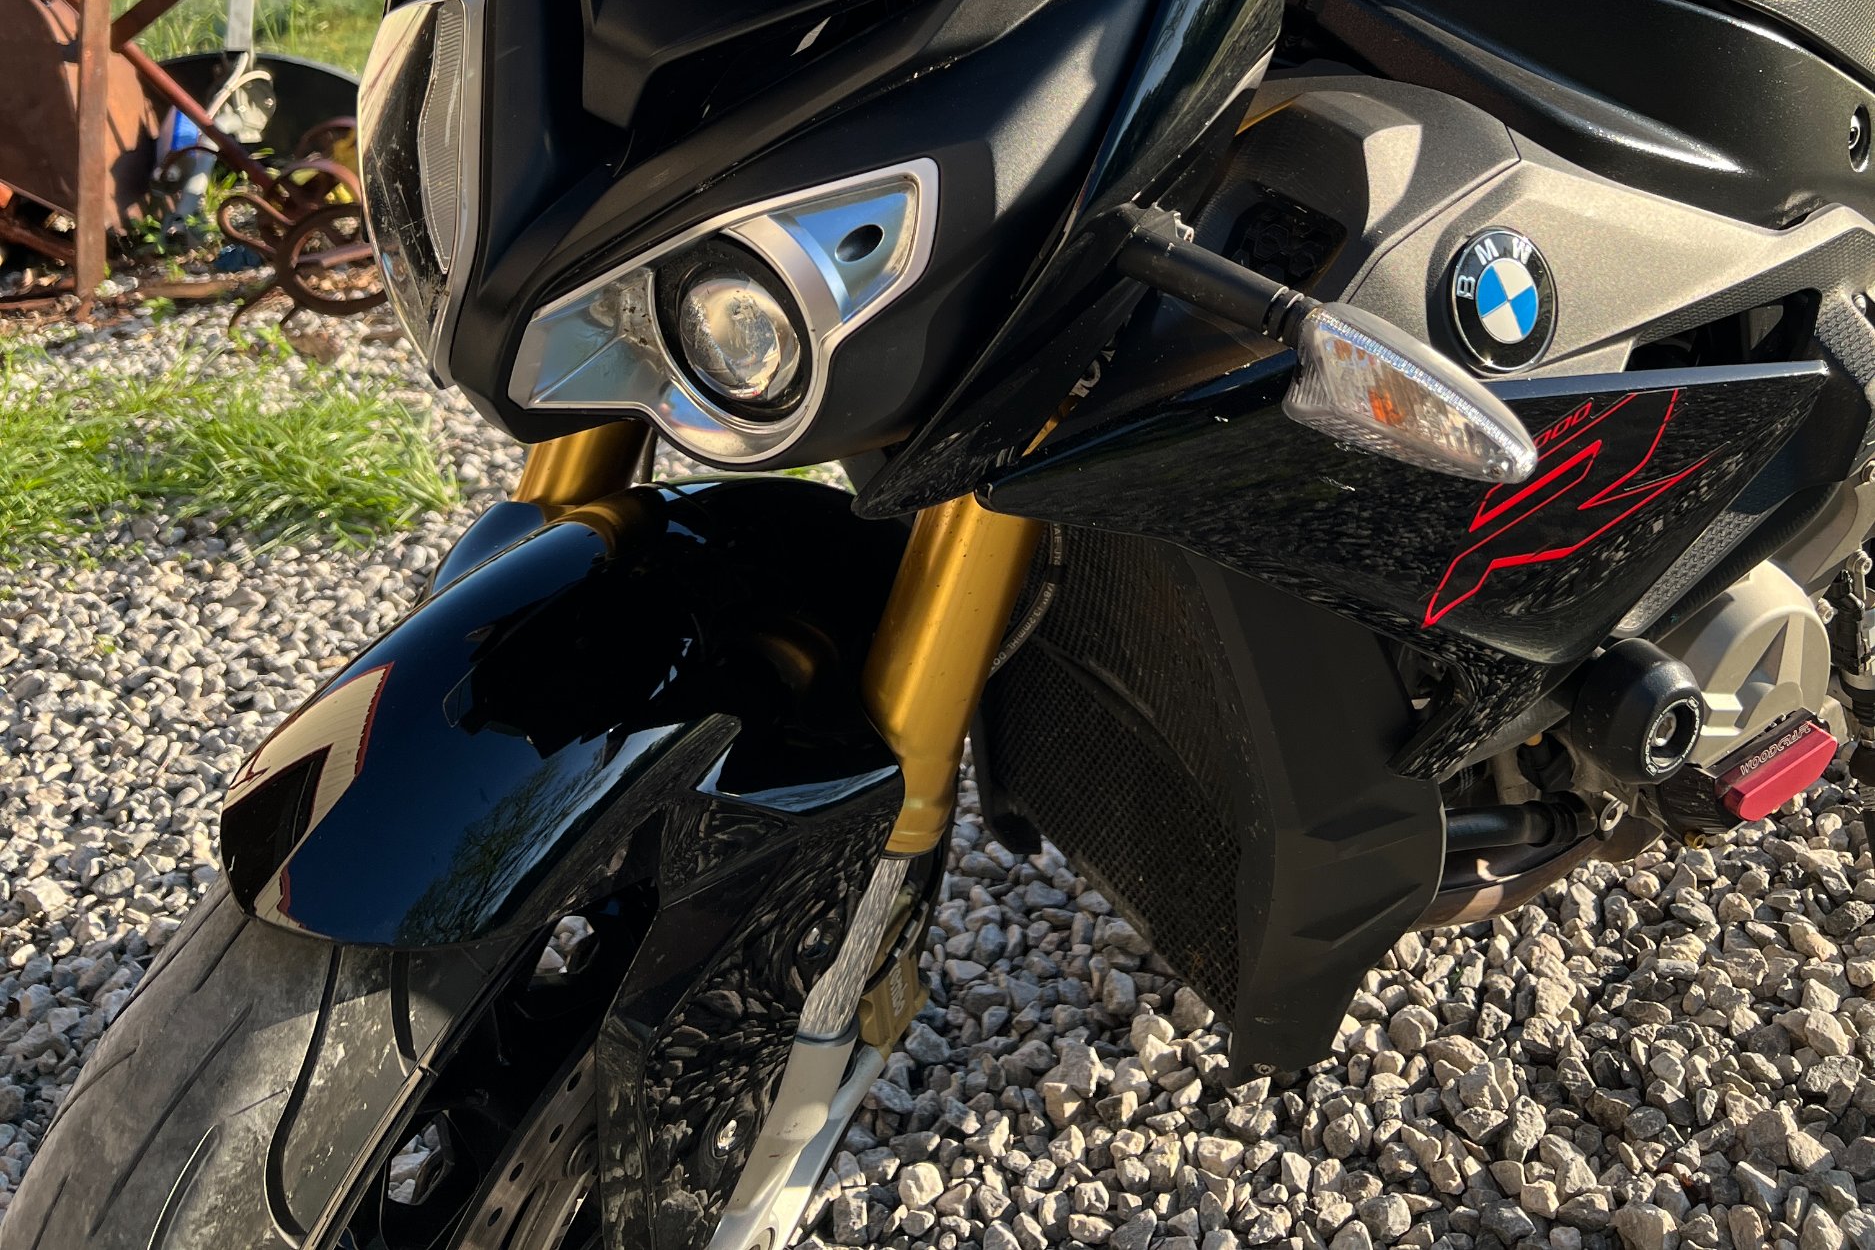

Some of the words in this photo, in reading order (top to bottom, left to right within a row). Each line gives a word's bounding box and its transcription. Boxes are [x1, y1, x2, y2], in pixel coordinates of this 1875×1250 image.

[1456, 237, 1533, 300] BMW
[1533, 402, 1592, 449] 000
[1740, 722, 1811, 776] WOODCRAFT
